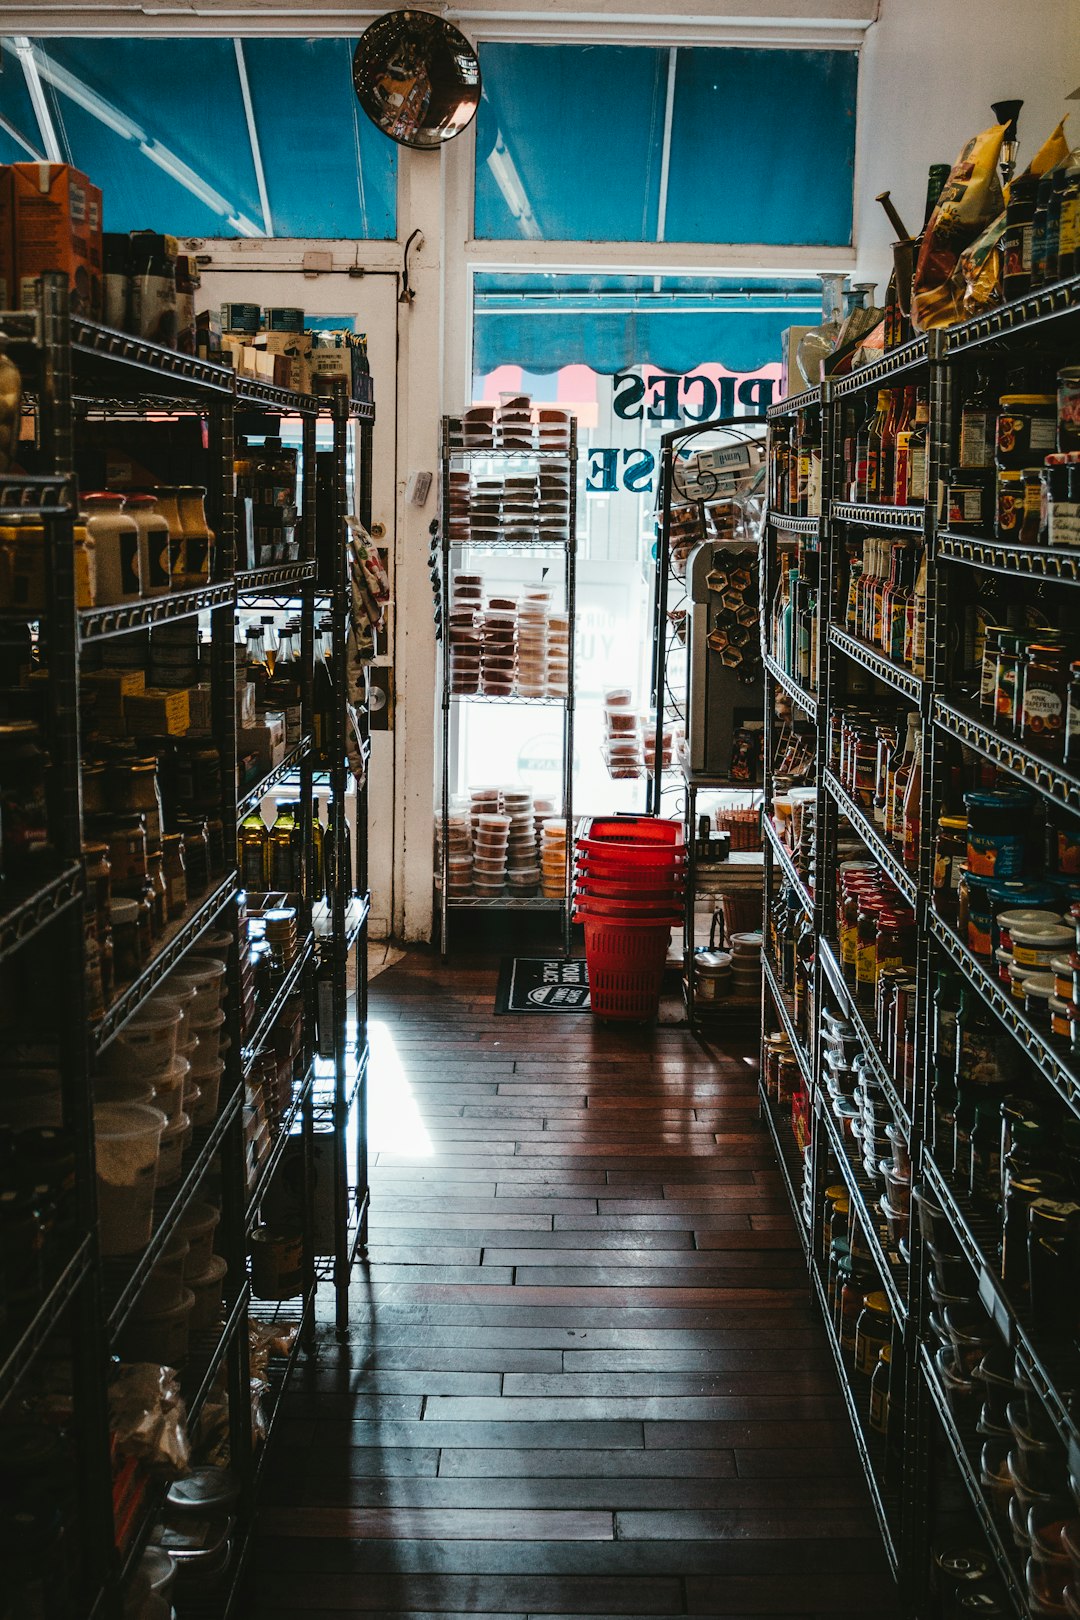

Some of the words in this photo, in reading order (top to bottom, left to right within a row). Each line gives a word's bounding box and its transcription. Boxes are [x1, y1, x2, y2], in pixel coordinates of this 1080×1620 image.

[1025, 700, 1060, 709] RAPEFRUIT
[543, 962, 559, 983] PLACE
[561, 963, 580, 983] YOUR
[549, 988, 570, 1003] SMALL
